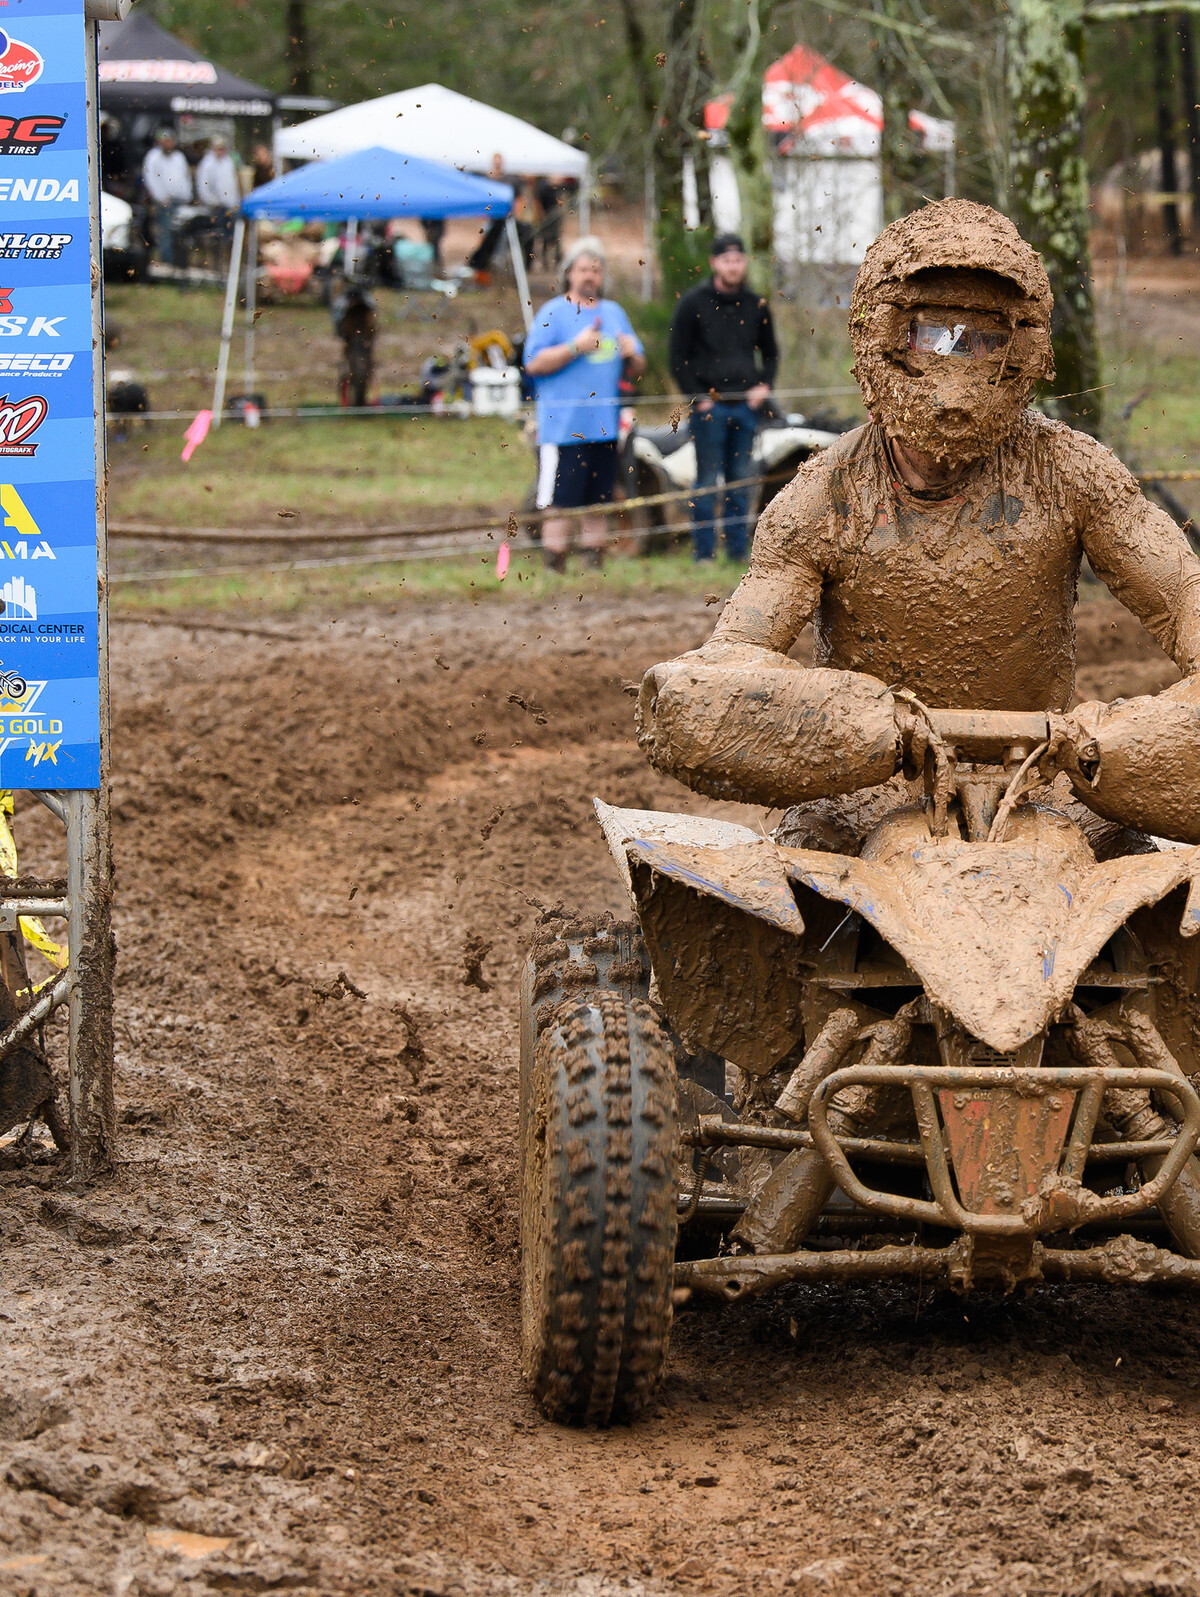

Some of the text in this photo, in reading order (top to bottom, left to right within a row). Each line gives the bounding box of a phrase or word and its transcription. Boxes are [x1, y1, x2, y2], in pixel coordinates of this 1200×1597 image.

[0, 81, 24, 89] ELS
[8, 146, 38, 154] TIRES
[0, 178, 79, 202] ENDA
[25, 249, 61, 258] TIRES
[38, 624, 84, 634] CENTER
[9, 719, 63, 734] GOLD
[25, 737, 63, 768] MX
